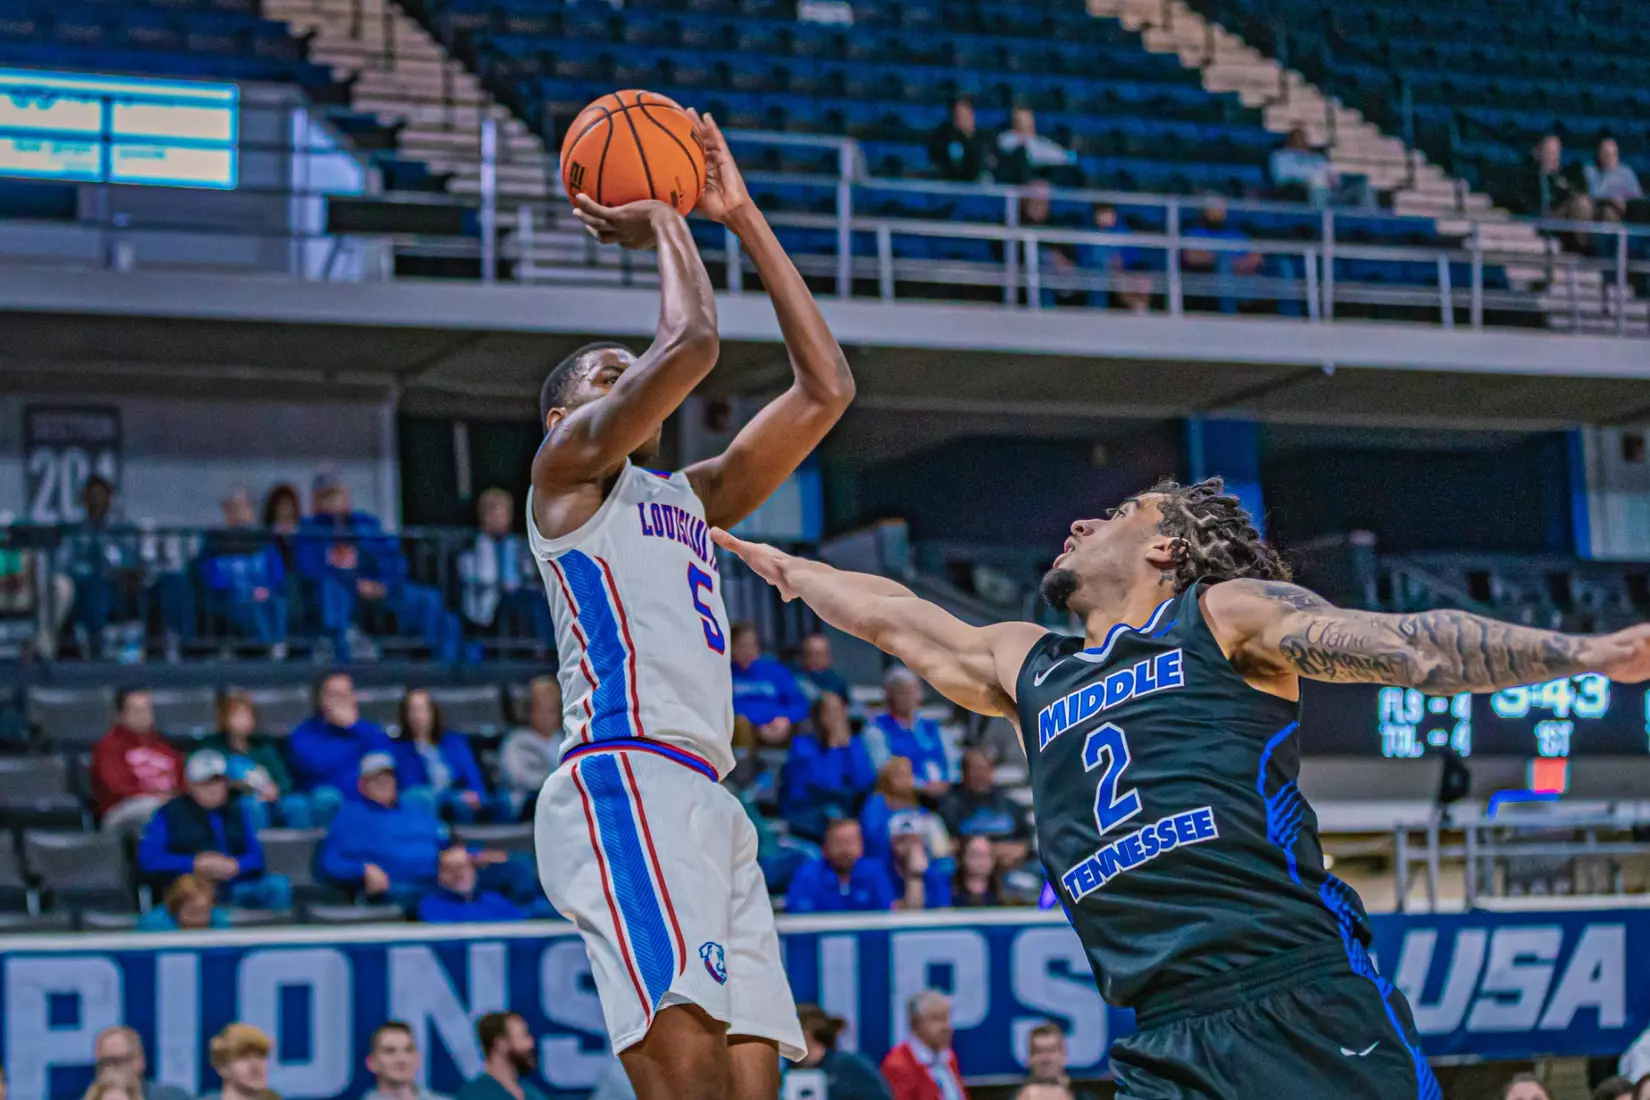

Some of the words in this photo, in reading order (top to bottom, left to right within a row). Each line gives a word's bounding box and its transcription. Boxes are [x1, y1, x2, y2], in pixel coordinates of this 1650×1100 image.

[637, 502, 719, 572] LOUISIAN
[687, 561, 725, 655] 5
[1038, 648, 1185, 752] MIDDLE
[1081, 721, 1143, 836] 2
[1061, 806, 1219, 904] TENNESSEE
